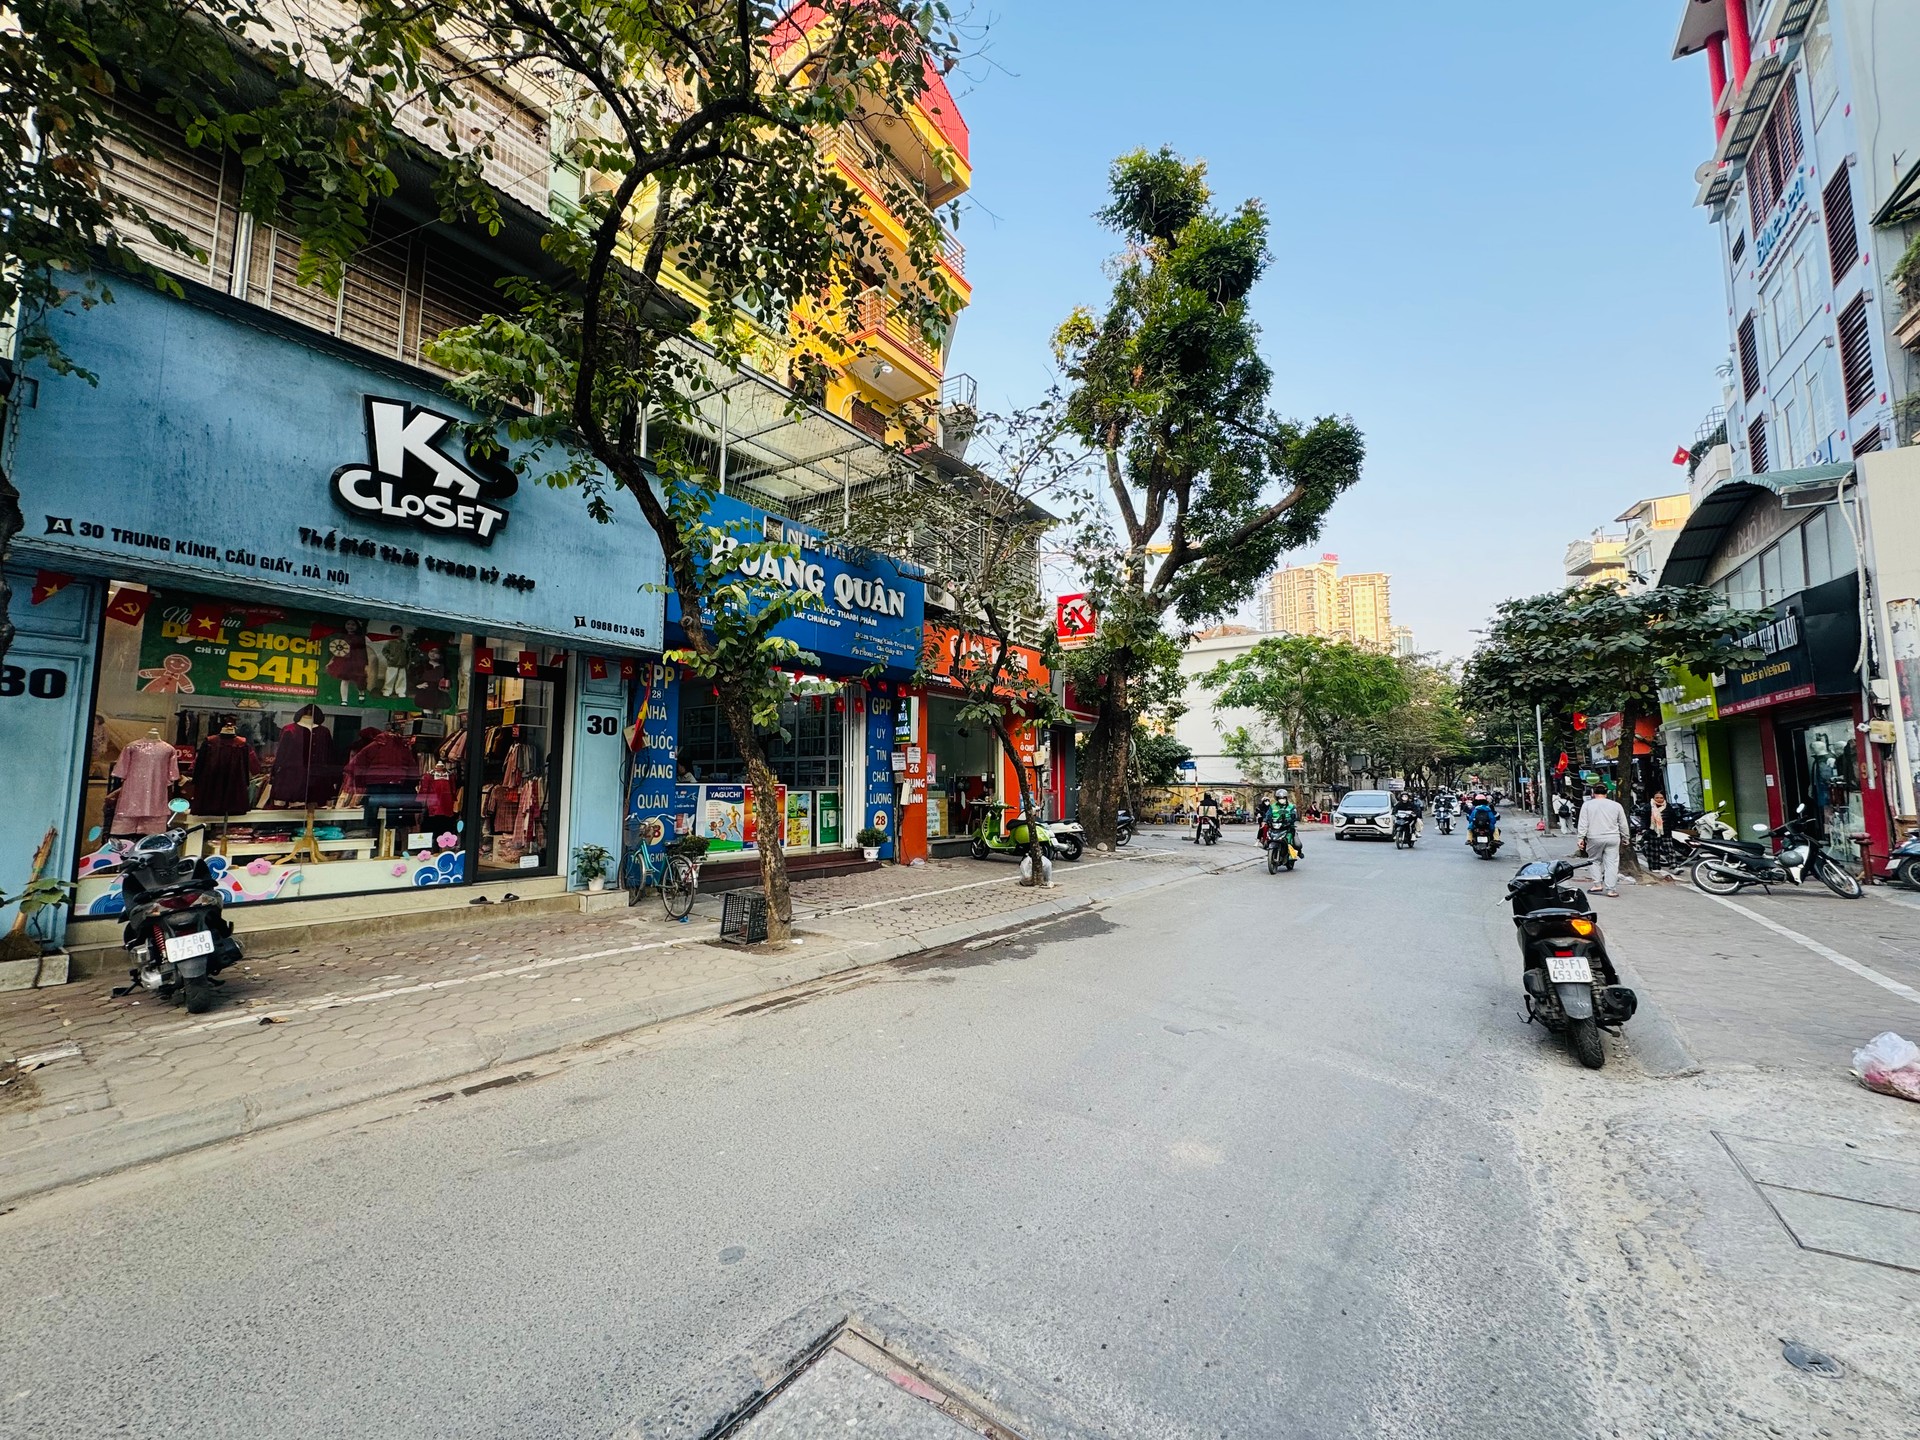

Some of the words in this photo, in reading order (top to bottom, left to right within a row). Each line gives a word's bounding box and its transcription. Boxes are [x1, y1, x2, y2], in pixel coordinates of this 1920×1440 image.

[338, 468, 502, 537] CLOSET
[52, 519, 67, 532] A
[79, 521, 104, 539] 30
[111, 527, 170, 552] TRUNG
[175, 539, 221, 563] KÍNH,
[225, 549, 256, 567] CẦU
[260, 555, 298, 577] GIẤY,
[302, 563, 322, 580] HÀ
[326, 568, 350, 585] NỘI
[833, 573, 906, 618] QUÂN
[576, 617, 584, 626] T
[590, 619, 613, 631] 0968
[613, 624, 628, 635] 613
[630, 627, 645, 638] 455
[829, 620, 842, 628] GPP
[1775, 605, 1798, 651] KHẨU
[213, 648, 228, 656] TỪ
[227, 651, 319, 687] 54K
[640, 663, 675, 690] GPP
[1741, 671, 1758, 685] Made
[1758, 671, 1764, 680] in
[1764, 661, 1791, 678] Vietnam
[651, 689, 662, 699] 28
[872, 697, 892, 715] GPP
[586, 714, 618, 736] 30
[876, 727, 886, 739] UY
[633, 760, 673, 779] HOÀNG
[872, 767, 890, 783] CHẤT
[909, 763, 920, 774] 26
[637, 791, 669, 809] QUÂN
[869, 792, 892, 808] LƯỢNG
[875, 815, 886, 826] 28
[1552, 959, 1582, 970] 29-F1
